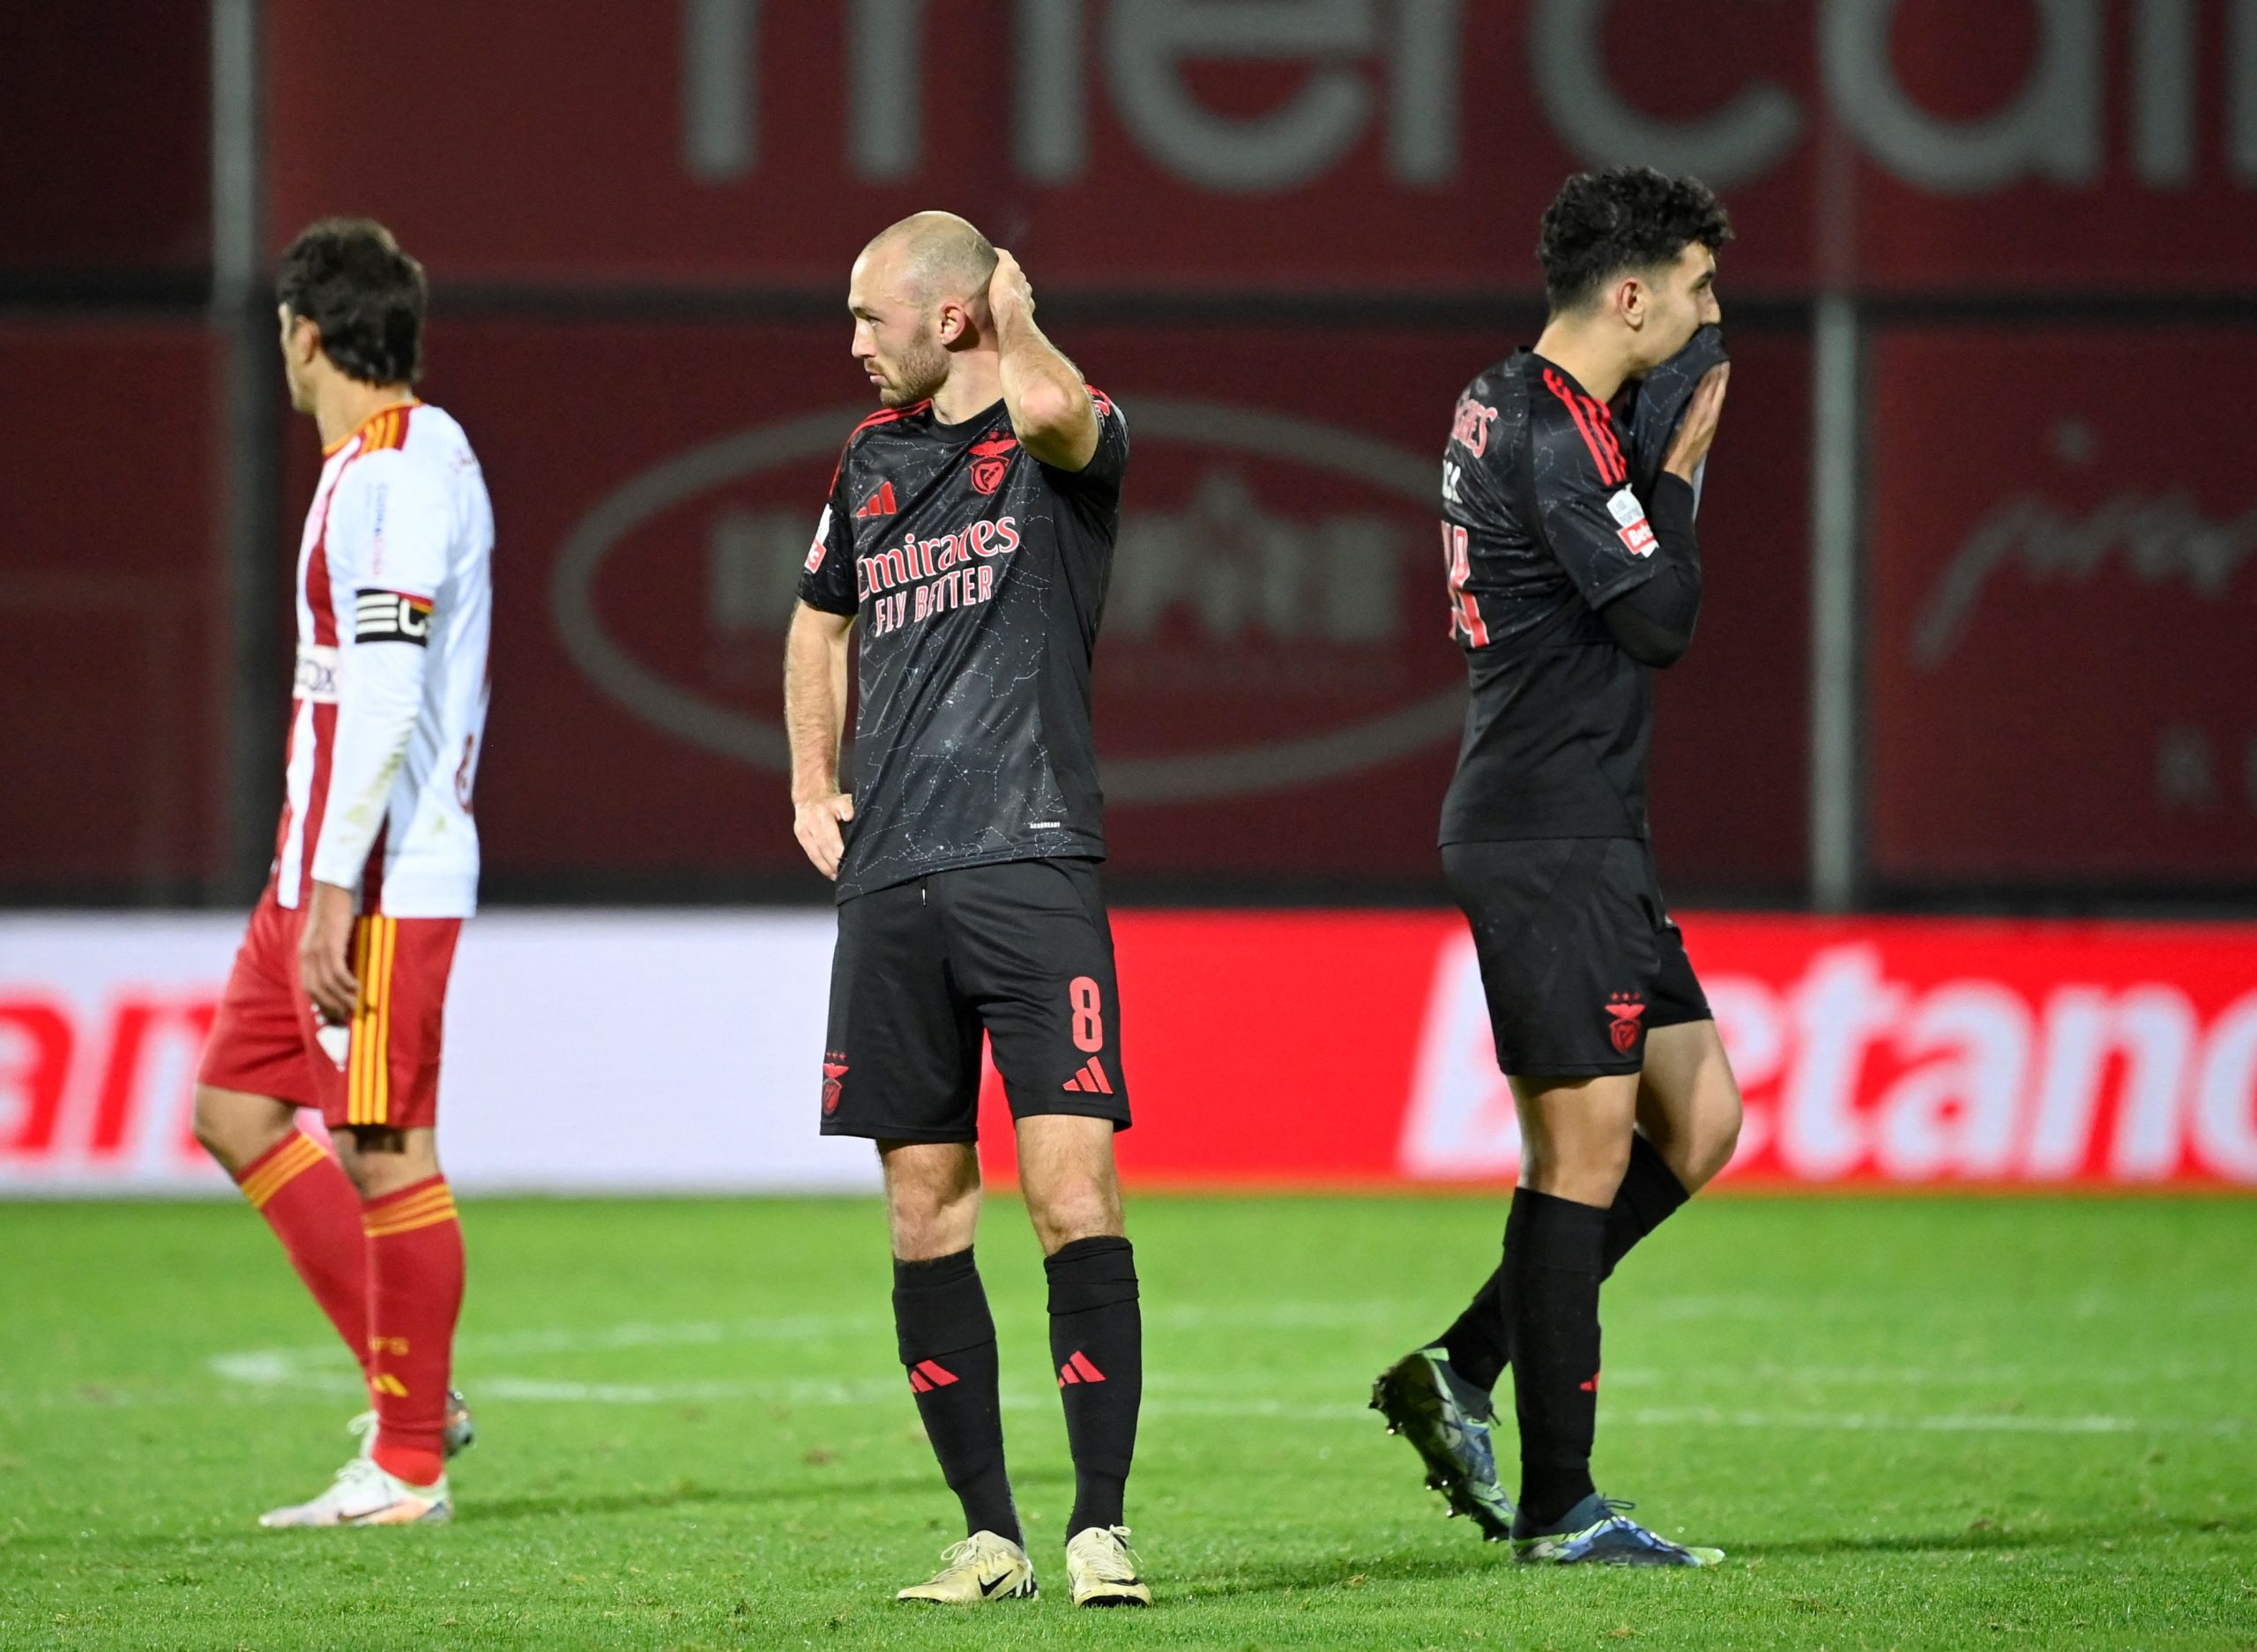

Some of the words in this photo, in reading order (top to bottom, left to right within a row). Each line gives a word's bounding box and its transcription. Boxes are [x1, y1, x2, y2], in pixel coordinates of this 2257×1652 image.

[875, 590, 907, 638] FLY
[913, 564, 994, 623] BETTER
[1068, 975, 1104, 1053] 8
